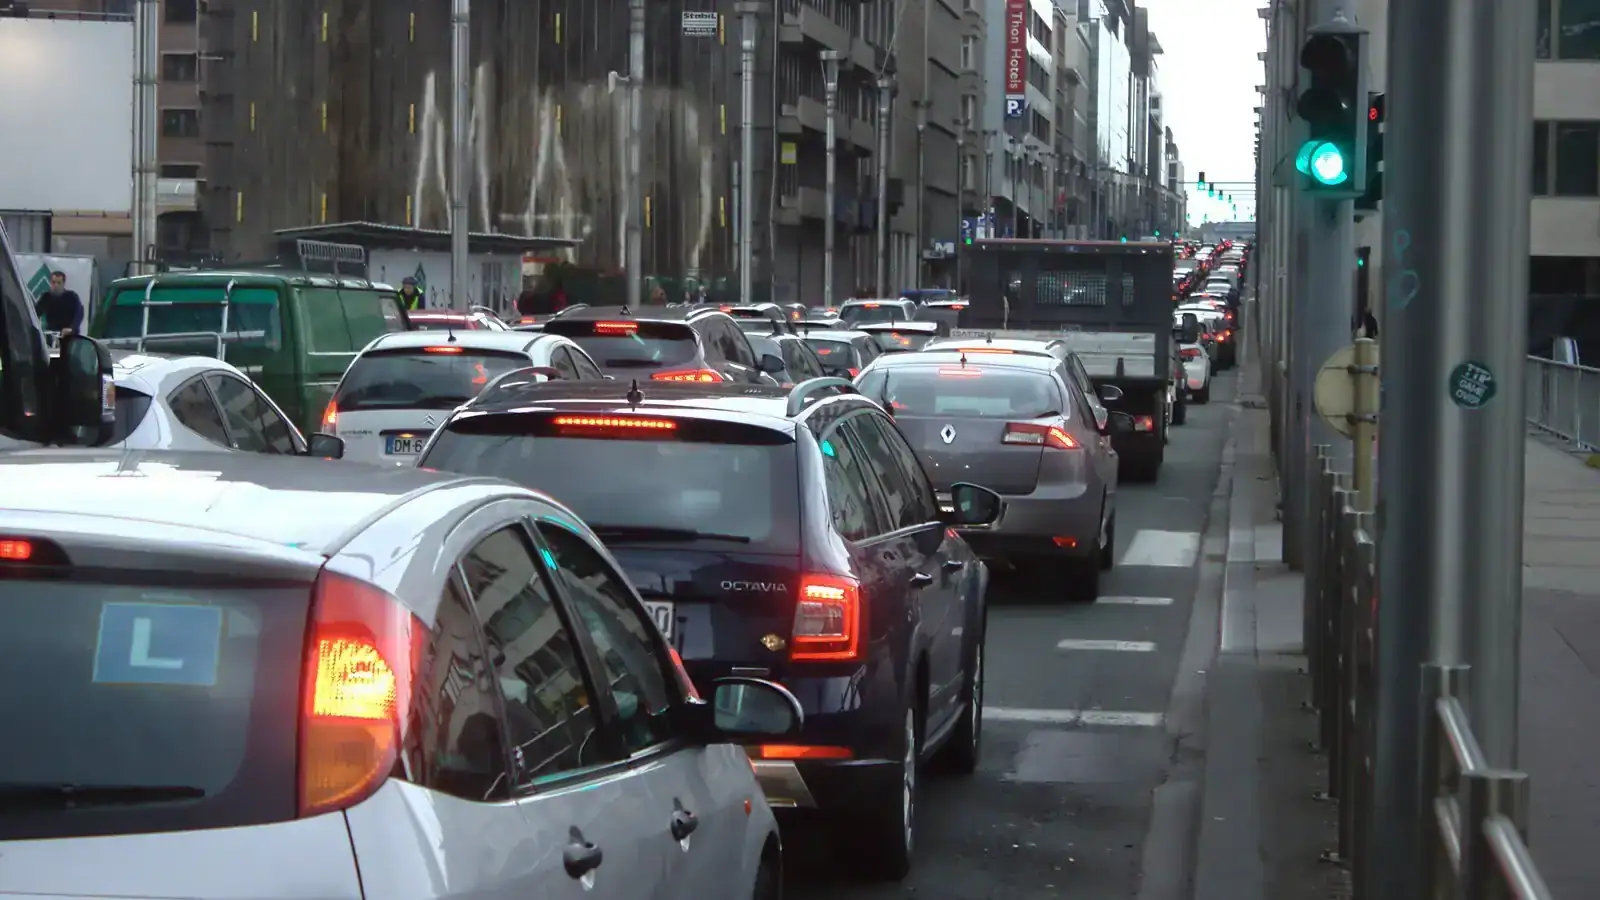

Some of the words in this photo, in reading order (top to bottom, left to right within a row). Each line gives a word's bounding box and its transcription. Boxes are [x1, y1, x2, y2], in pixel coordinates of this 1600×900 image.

[1011, 12, 1023, 44] Thon
[1010, 48, 1022, 89] Hotels
[720, 580, 788, 593] OCTAVIA
[130, 617, 184, 669] L
